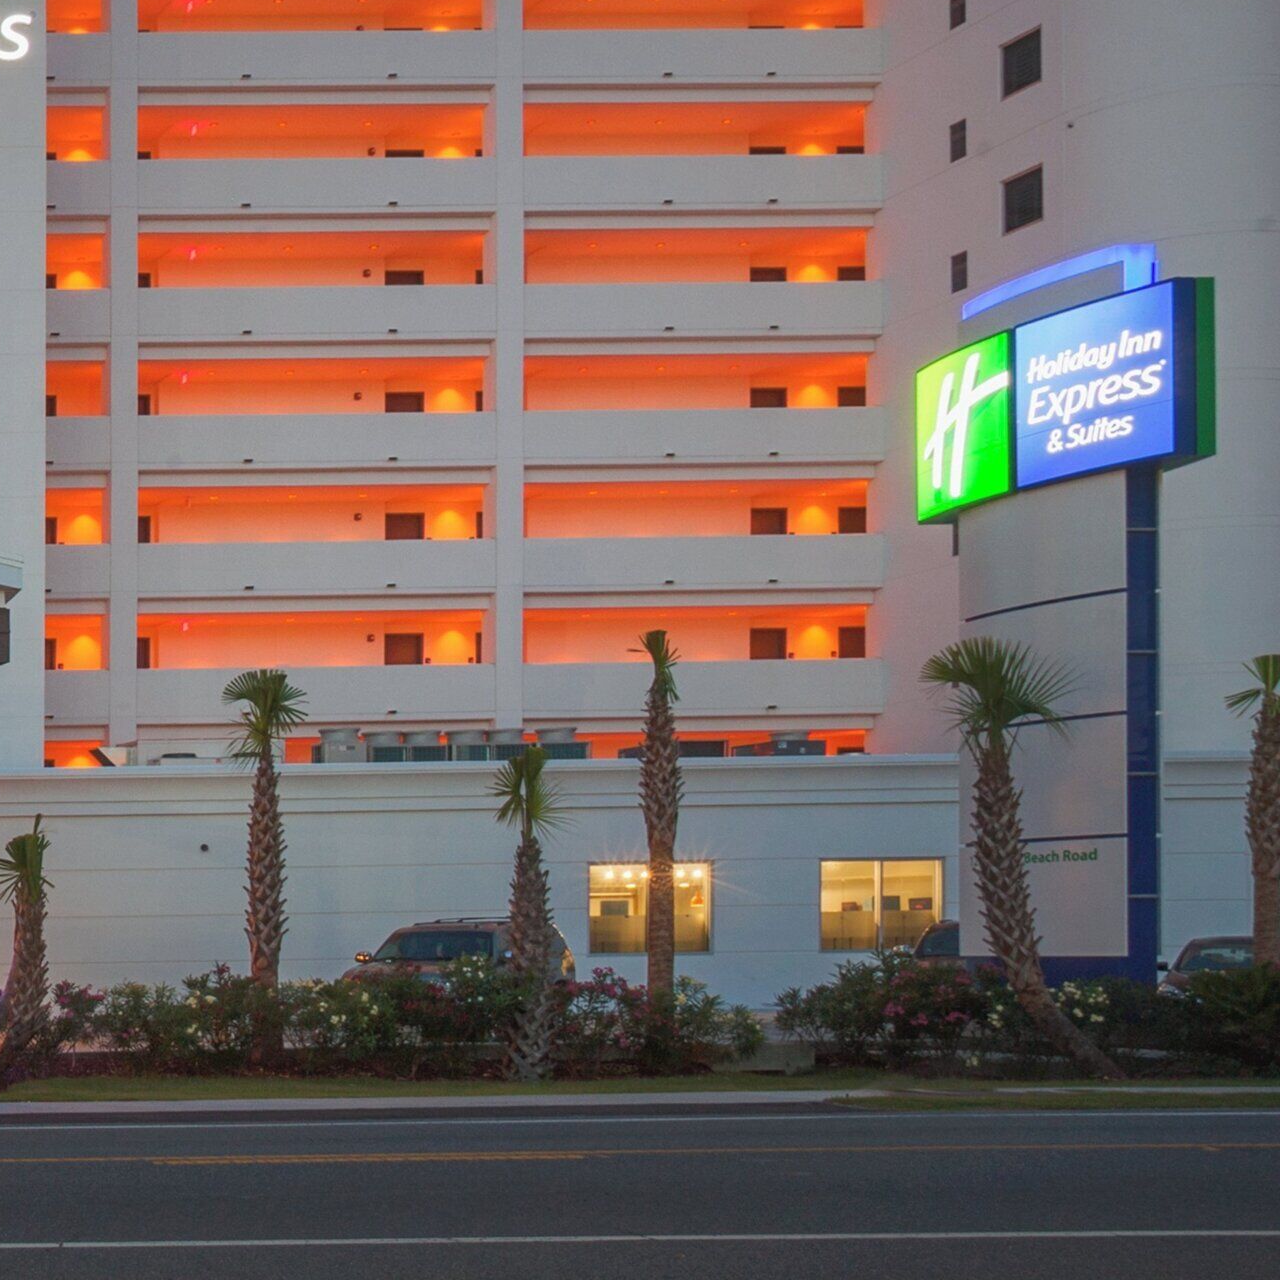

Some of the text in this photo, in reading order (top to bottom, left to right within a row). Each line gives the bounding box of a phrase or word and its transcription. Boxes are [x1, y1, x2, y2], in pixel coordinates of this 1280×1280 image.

[1027, 329, 1162, 383] Holiday Inn
[1027, 364, 1163, 425] Express
[1046, 415, 1134, 453] & Suites
[1024, 848, 1097, 863] Beach Road
